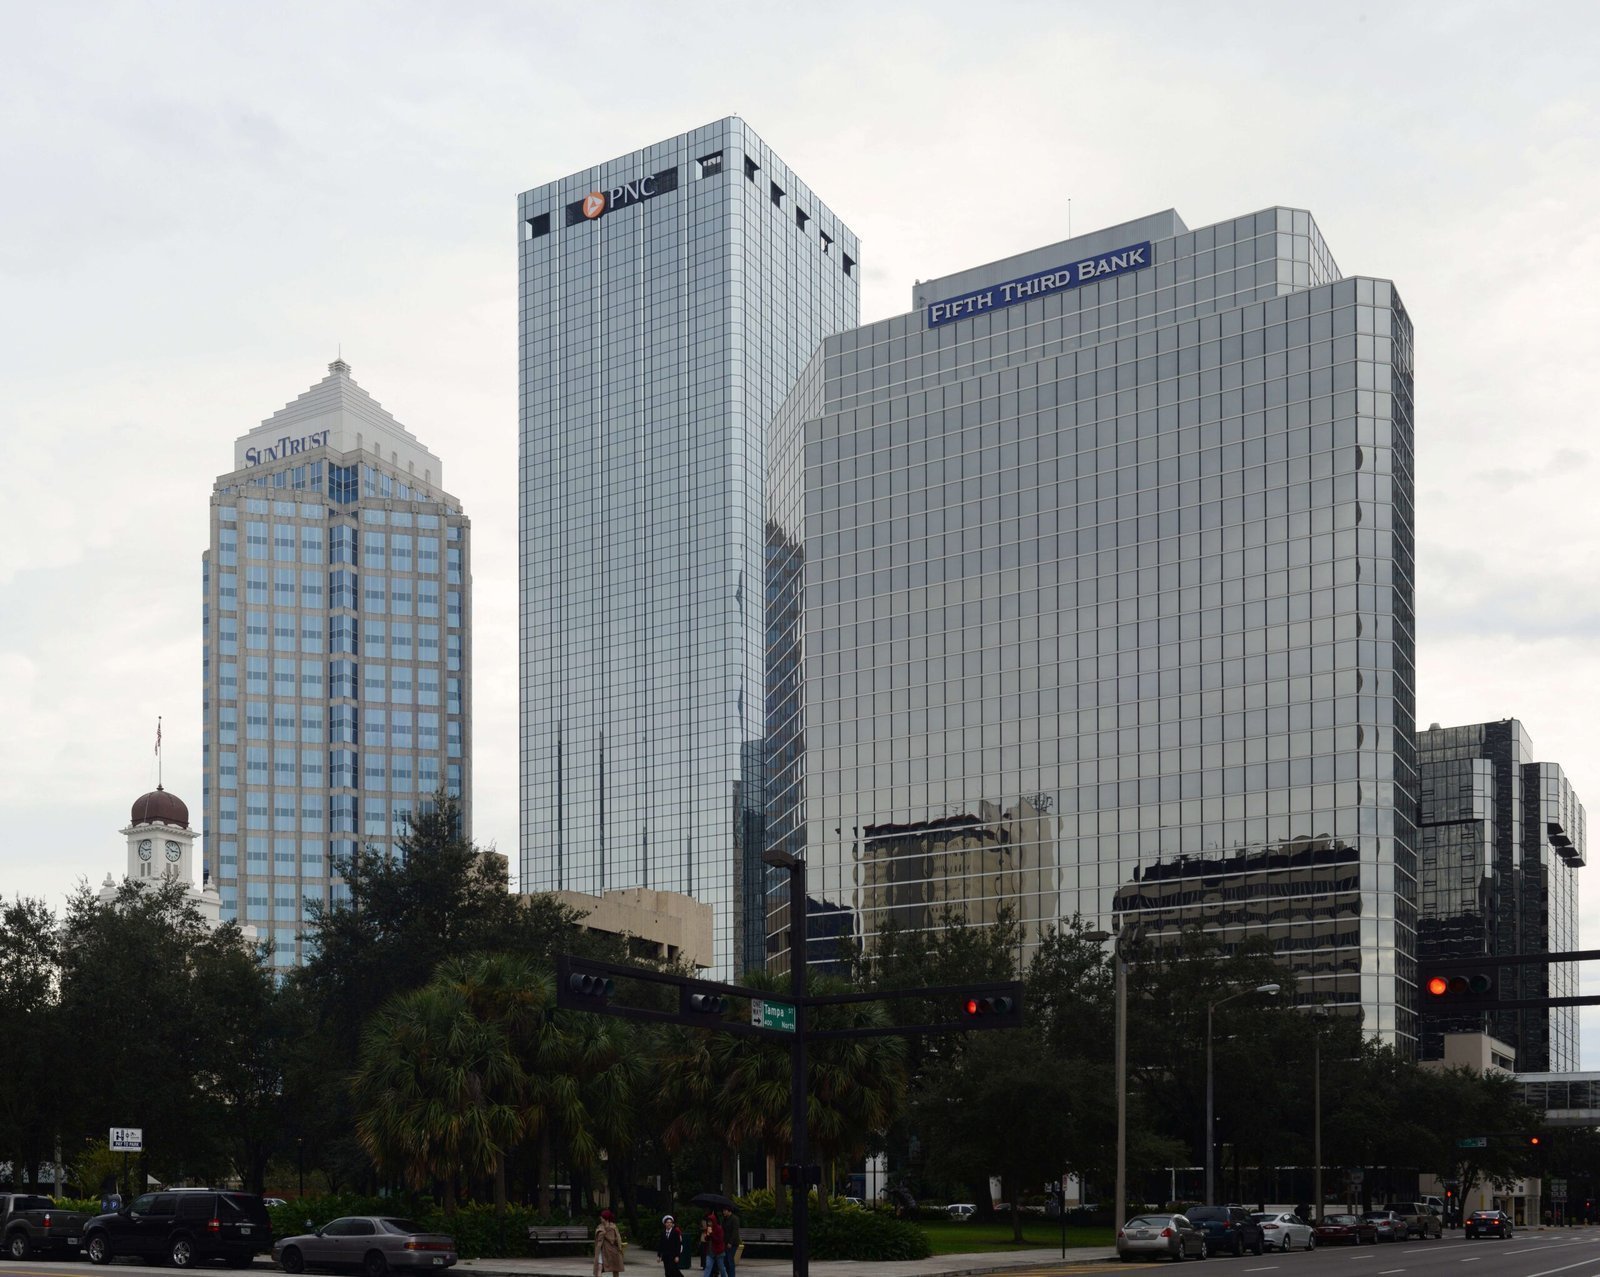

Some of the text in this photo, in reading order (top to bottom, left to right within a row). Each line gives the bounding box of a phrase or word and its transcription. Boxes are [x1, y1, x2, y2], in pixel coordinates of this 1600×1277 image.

[609, 175, 656, 208] PNC
[931, 247, 1145, 323] FIFTH THIRD BANK
[245, 429, 330, 469] SUNTRUST
[764, 1004, 784, 1018] Tampa
[781, 1020, 794, 1030] North
